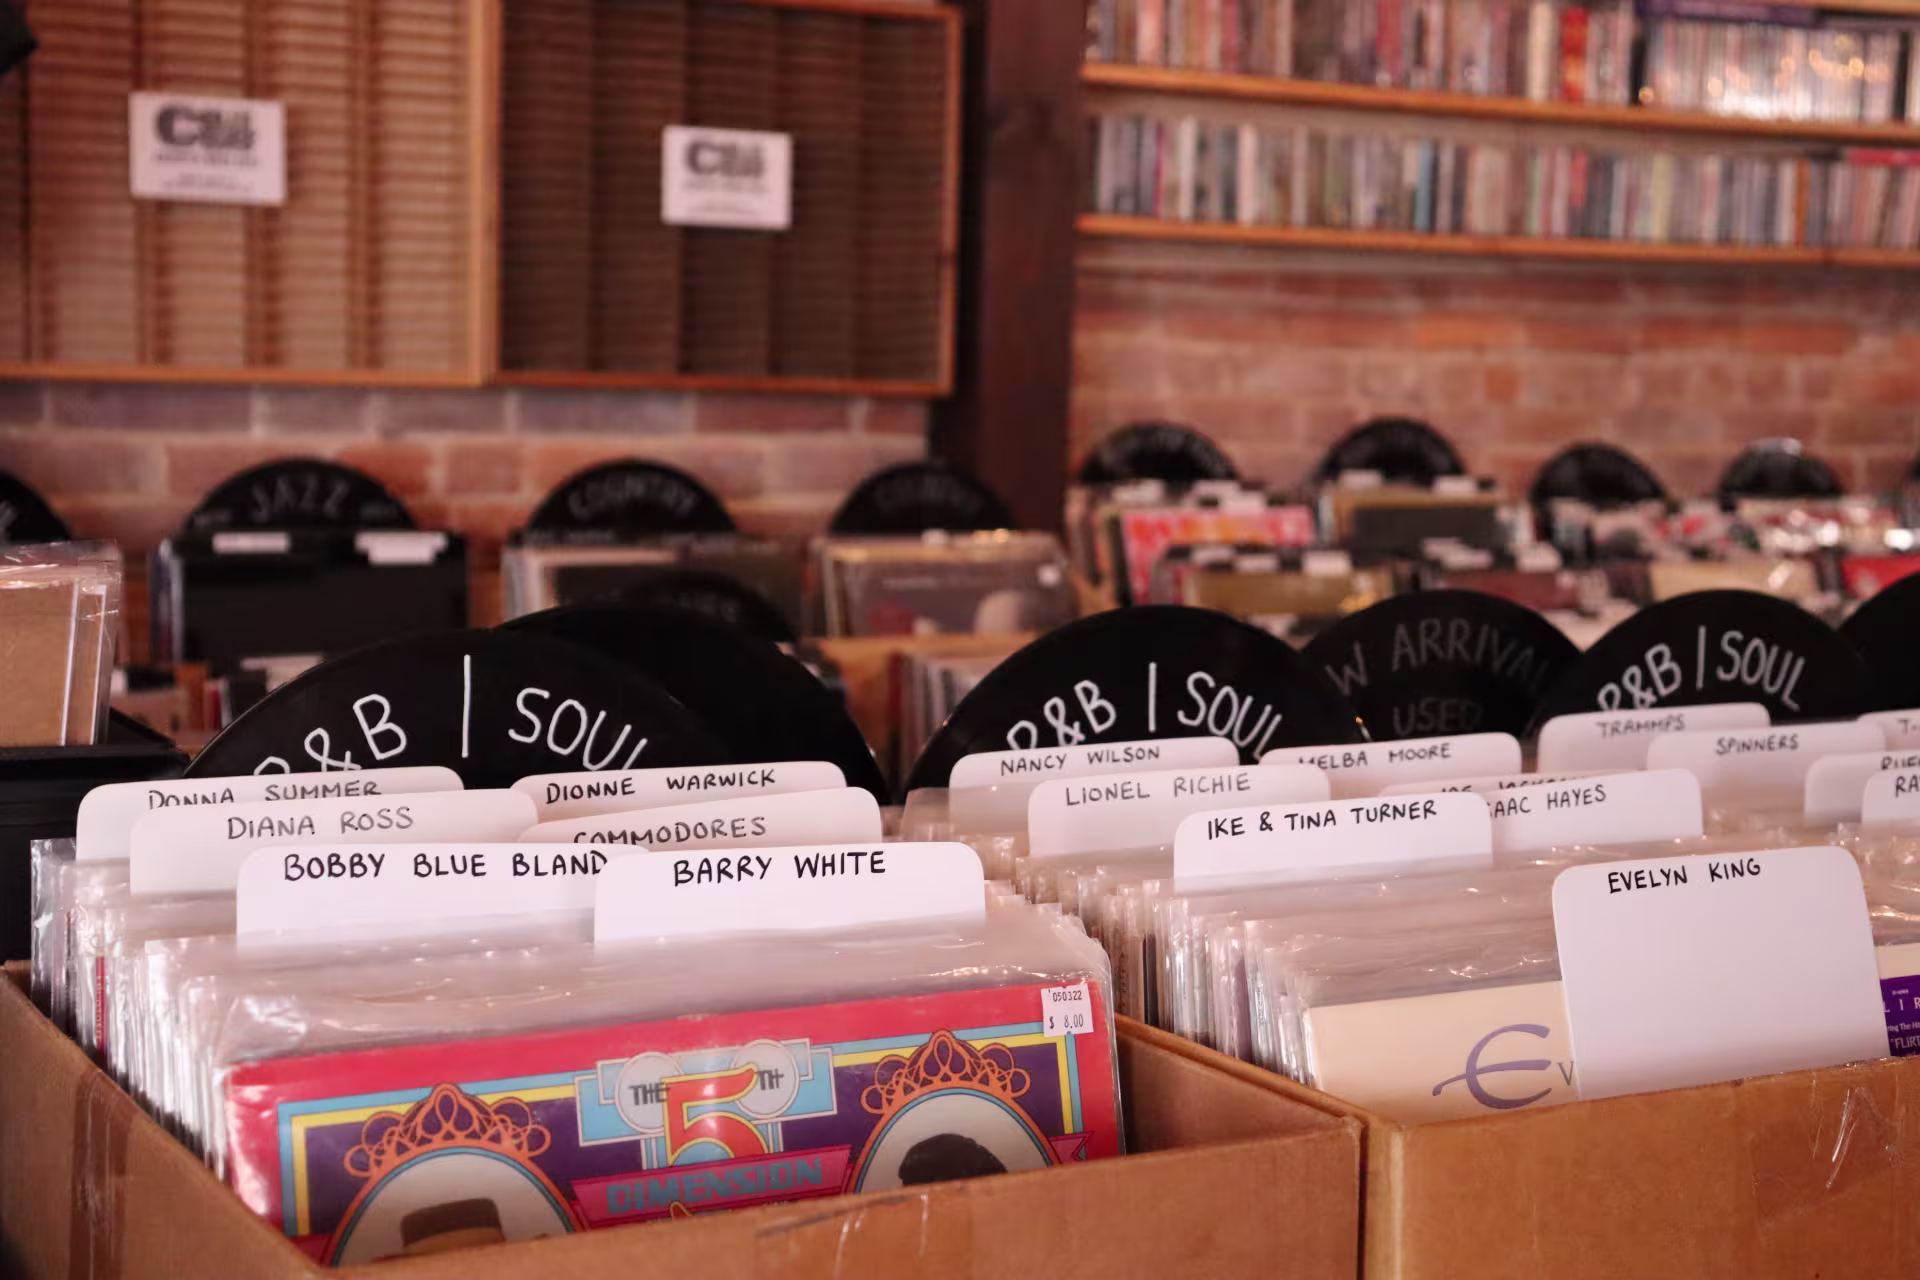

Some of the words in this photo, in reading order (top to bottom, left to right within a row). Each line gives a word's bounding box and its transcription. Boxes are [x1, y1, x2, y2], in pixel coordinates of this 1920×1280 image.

[252, 472, 351, 523] JAZZ
[1716, 630, 1805, 712] SOUL
[254, 694, 408, 775] &B
[1596, 714, 1686, 738] TRAMMPS
[1000, 753, 1067, 776] NANCY
[1087, 746, 1160, 765] WILSON
[1388, 742, 1452, 763] MOORE
[1716, 734, 1800, 756] SPINNERS
[148, 788, 235, 810] DONNA
[265, 780, 381, 802] SUMMER
[546, 777, 635, 804] DIONNE
[666, 768, 776, 791] WARWICK
[1065, 781, 1151, 806] LIONEL
[1173, 772, 1251, 798] RICHIE
[1546, 784, 1607, 811] HAYES
[227, 815, 315, 839] DIANA
[340, 806, 413, 834] ROSS
[573, 816, 766, 845] COMMODORES
[1207, 816, 1246, 841] IKE
[1258, 811, 1274, 832] &
[1283, 809, 1337, 831] TINA
[1350, 799, 1438, 824] TURNER
[284, 852, 386, 882] BOBBY
[412, 852, 488, 878] BLUE
[511, 849, 608, 877] BLAND
[673, 855, 772, 887] BARRY
[794, 850, 886, 879] WHITE
[1607, 864, 1689, 894] EVELYN
[1708, 857, 1762, 883] KING
[1064, 1013, 1084, 1028] 8.00
[629, 1082, 671, 1106] THE
[757, 1068, 784, 1091] TH
[606, 1157, 823, 1214] DIMENSION
